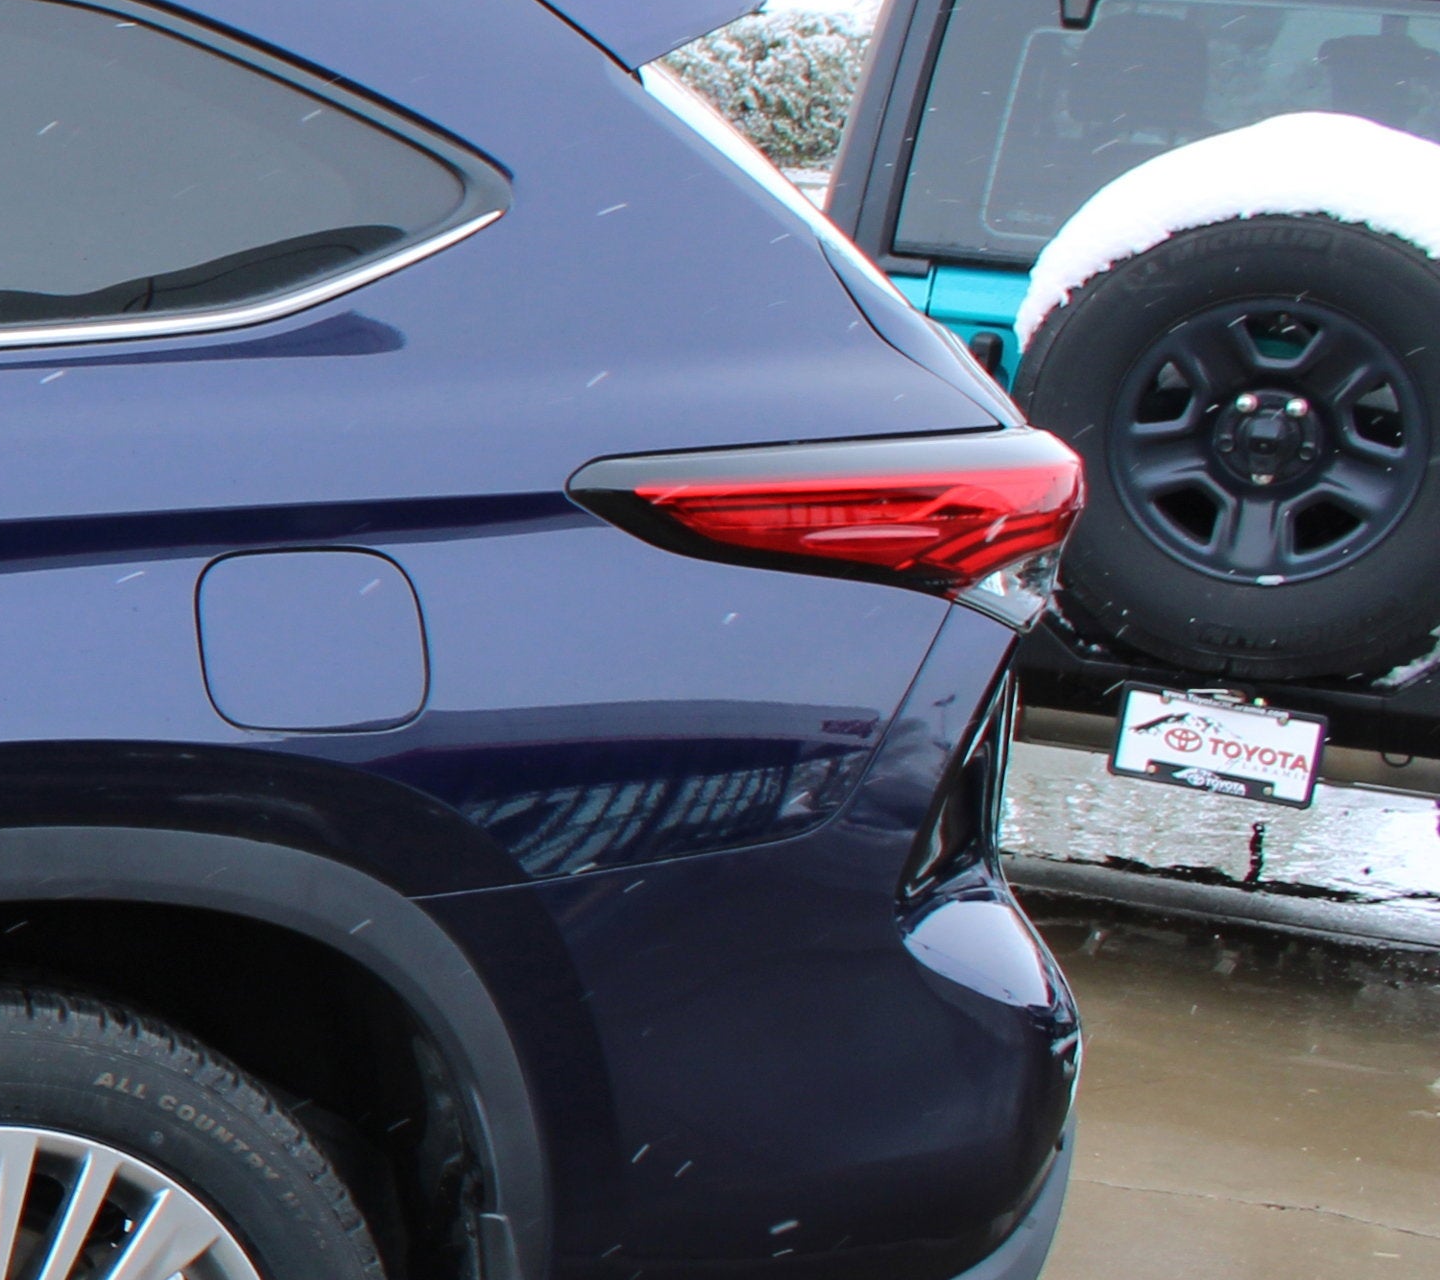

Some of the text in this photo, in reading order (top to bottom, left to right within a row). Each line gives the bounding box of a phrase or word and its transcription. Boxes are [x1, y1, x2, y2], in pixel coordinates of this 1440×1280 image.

[1208, 737, 1309, 772] TOYOTA
[92, 1071, 147, 1099] ALL
[156, 1094, 282, 1180] COUNTRY
